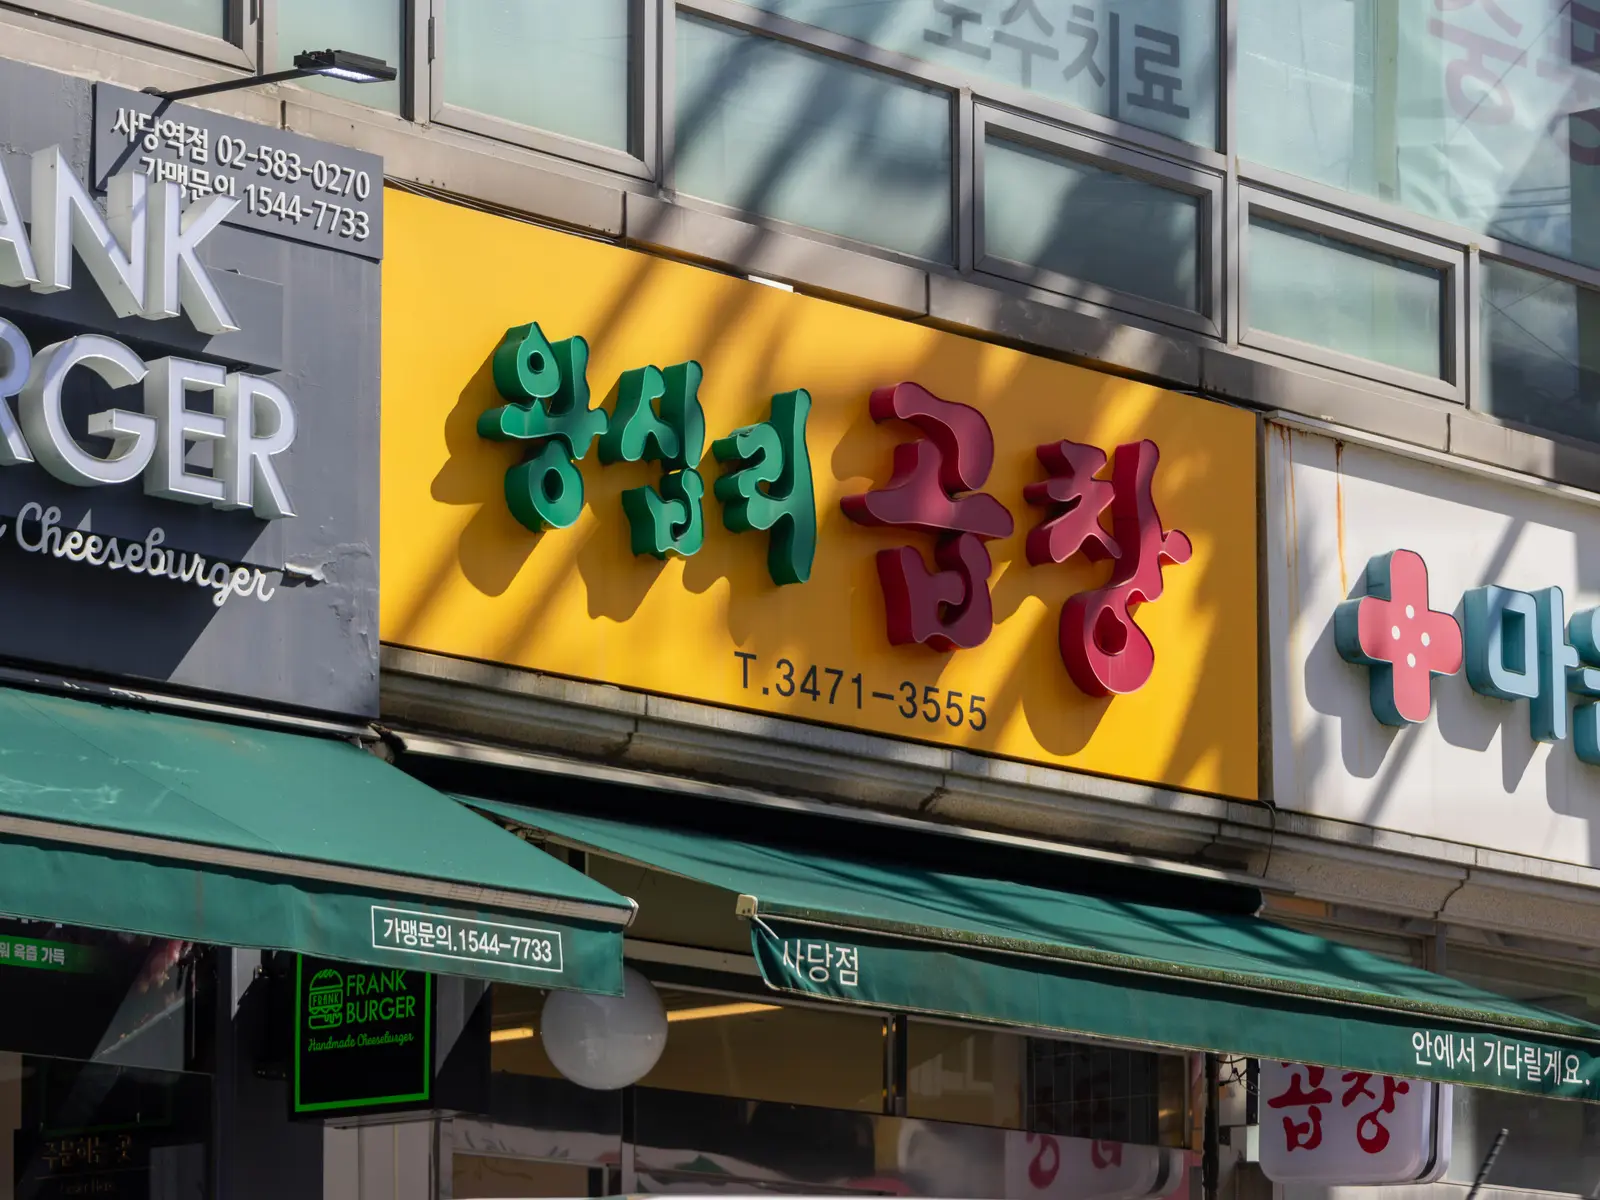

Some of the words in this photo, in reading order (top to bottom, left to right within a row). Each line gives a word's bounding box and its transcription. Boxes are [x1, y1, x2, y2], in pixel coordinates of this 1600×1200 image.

[112, 108, 209, 163] 사당역점
[217, 135, 371, 201] 02-583-0270
[245, 183, 370, 241] 1544-7733
[478, 321, 817, 586] 왕십리
[840, 381, 1193, 698] 곱창
[16, 502, 275, 607] Cheeseburger
[734, 651, 987, 732] T.3471-3555
[1463, 585, 1600, 767] 마
[41, 947, 65, 966] 가득
[383, 917, 552, 963] 가맹문의.1544-7733
[783, 939, 858, 987] 사당점
[312, 992, 339, 1007] FRANK
[346, 969, 407, 997] FRANK
[346, 995, 416, 1024] BURGER
[307, 1035, 356, 1052] Handmade
[356, 1030, 414, 1047] Cheeseburger
[1412, 1031, 1476, 1073] 안에서
[1483, 1040, 1591, 1086] 기다릴게요.
